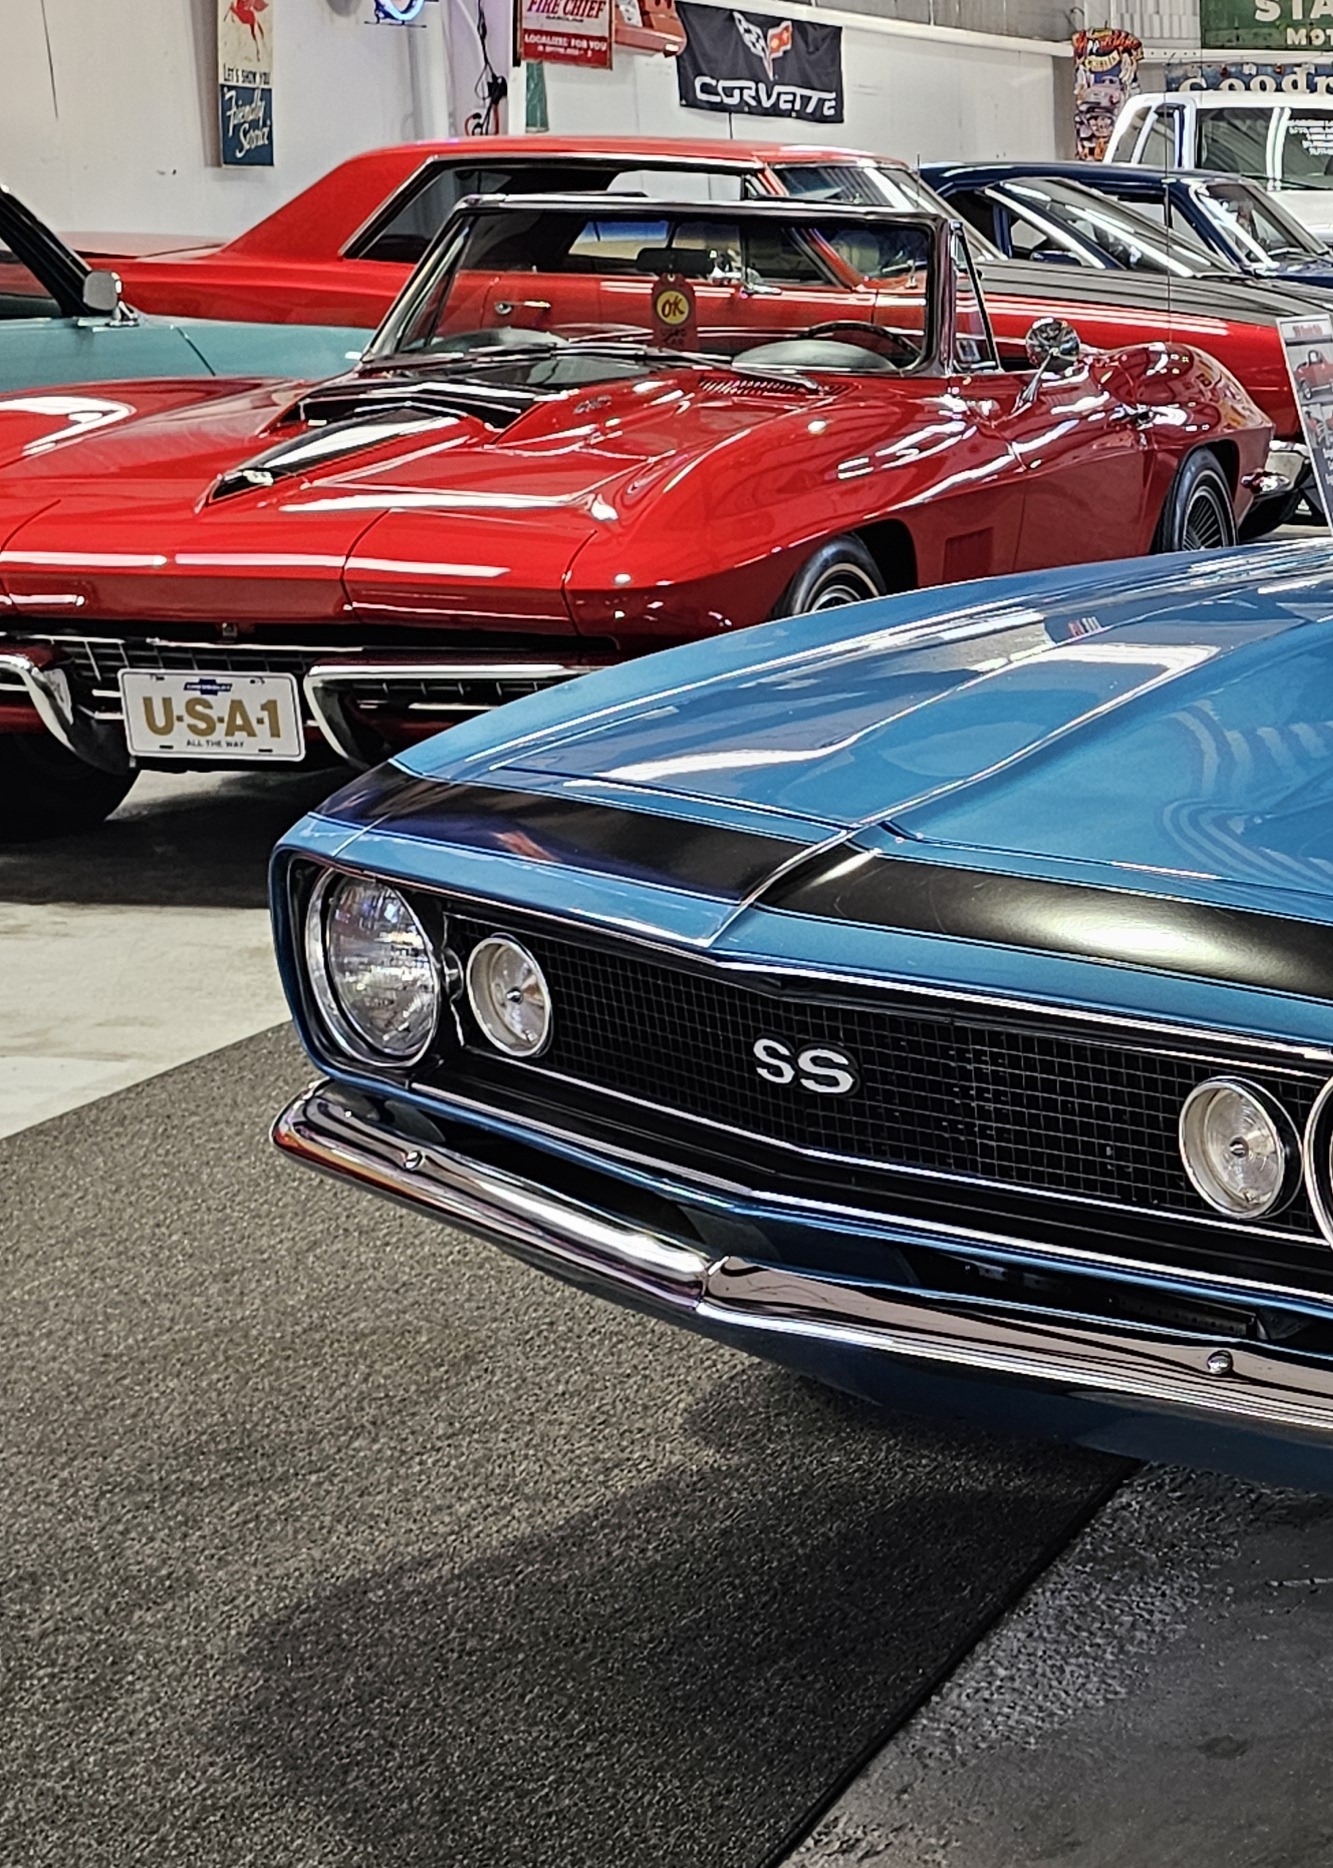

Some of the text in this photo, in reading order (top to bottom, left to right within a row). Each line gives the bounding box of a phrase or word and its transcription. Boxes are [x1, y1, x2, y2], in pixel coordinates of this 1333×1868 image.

[694, 75, 836, 116] CORVETTE
[661, 295, 686, 318] OK
[186, 739, 245, 749] ALL THE WAY
[753, 1038, 855, 1093] SS
